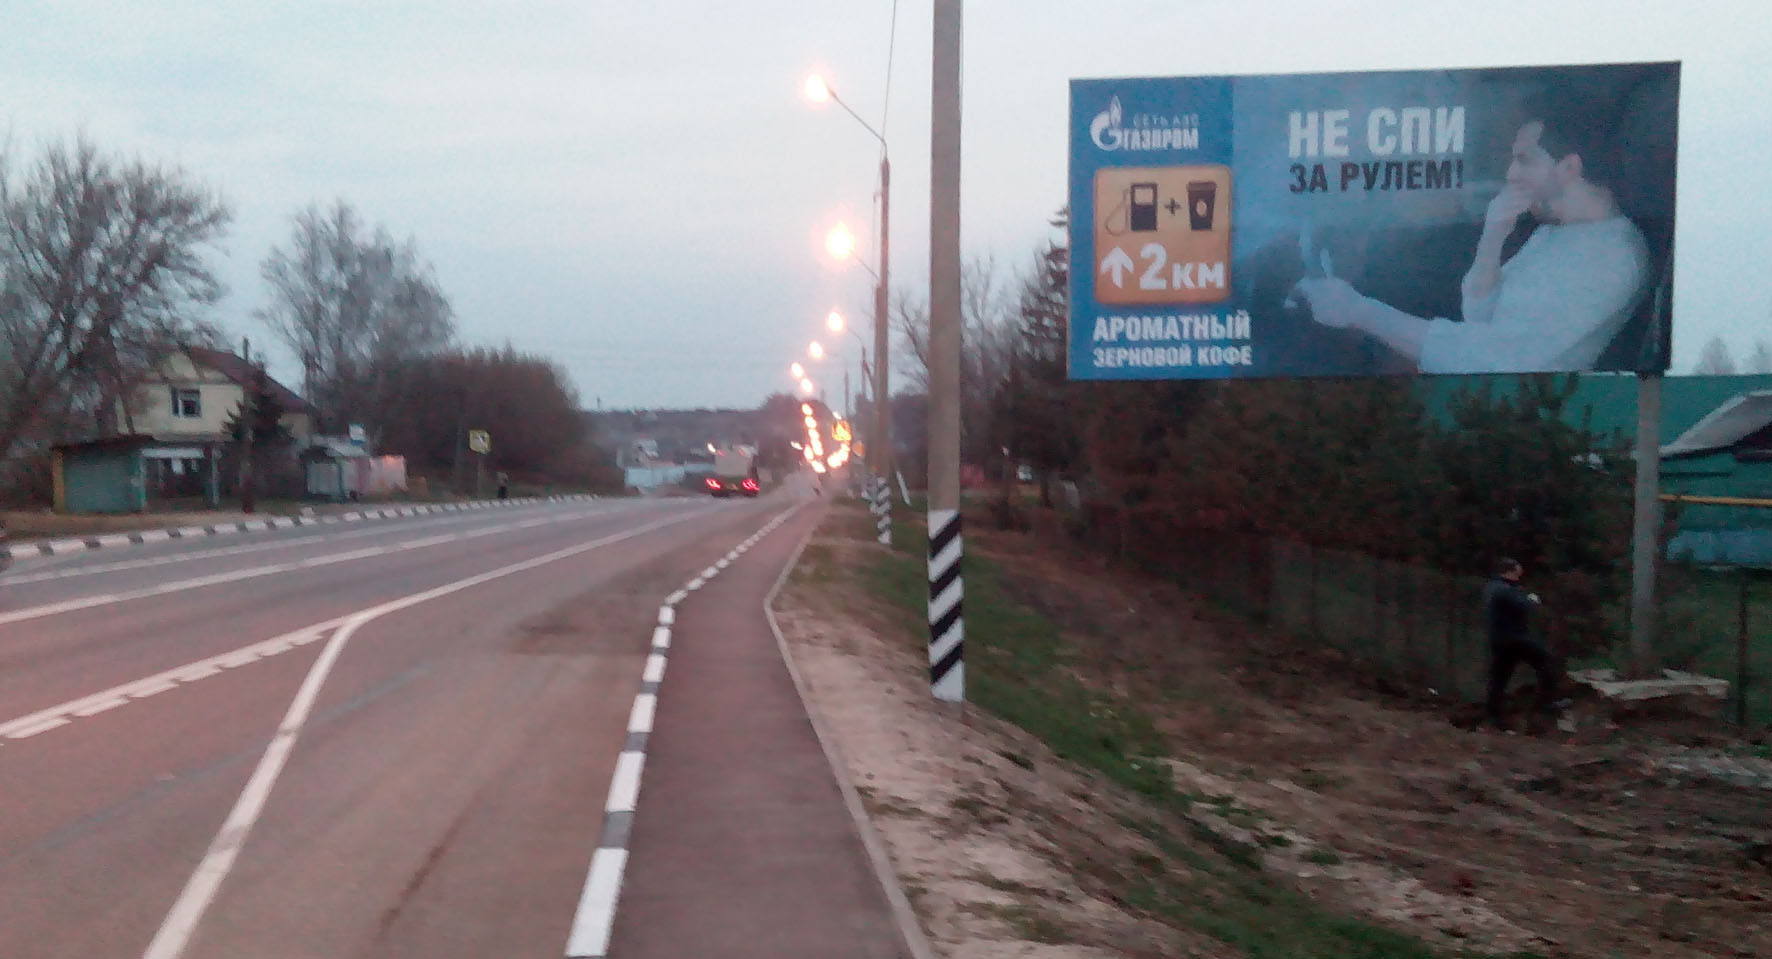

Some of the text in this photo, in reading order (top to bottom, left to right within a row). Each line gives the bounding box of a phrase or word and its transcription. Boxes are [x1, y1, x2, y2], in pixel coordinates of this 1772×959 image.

[1122, 128, 1199, 151] ГАЗПРОМ
[1289, 107, 1465, 158] НЕ СПИ
[1289, 160, 1464, 194] ЗА РУЛЕМ!
[1093, 310, 1252, 342] АРОМАТНЫЙ
[1093, 345, 1253, 368] ЗЕРНОВОЙ КОФЕ
